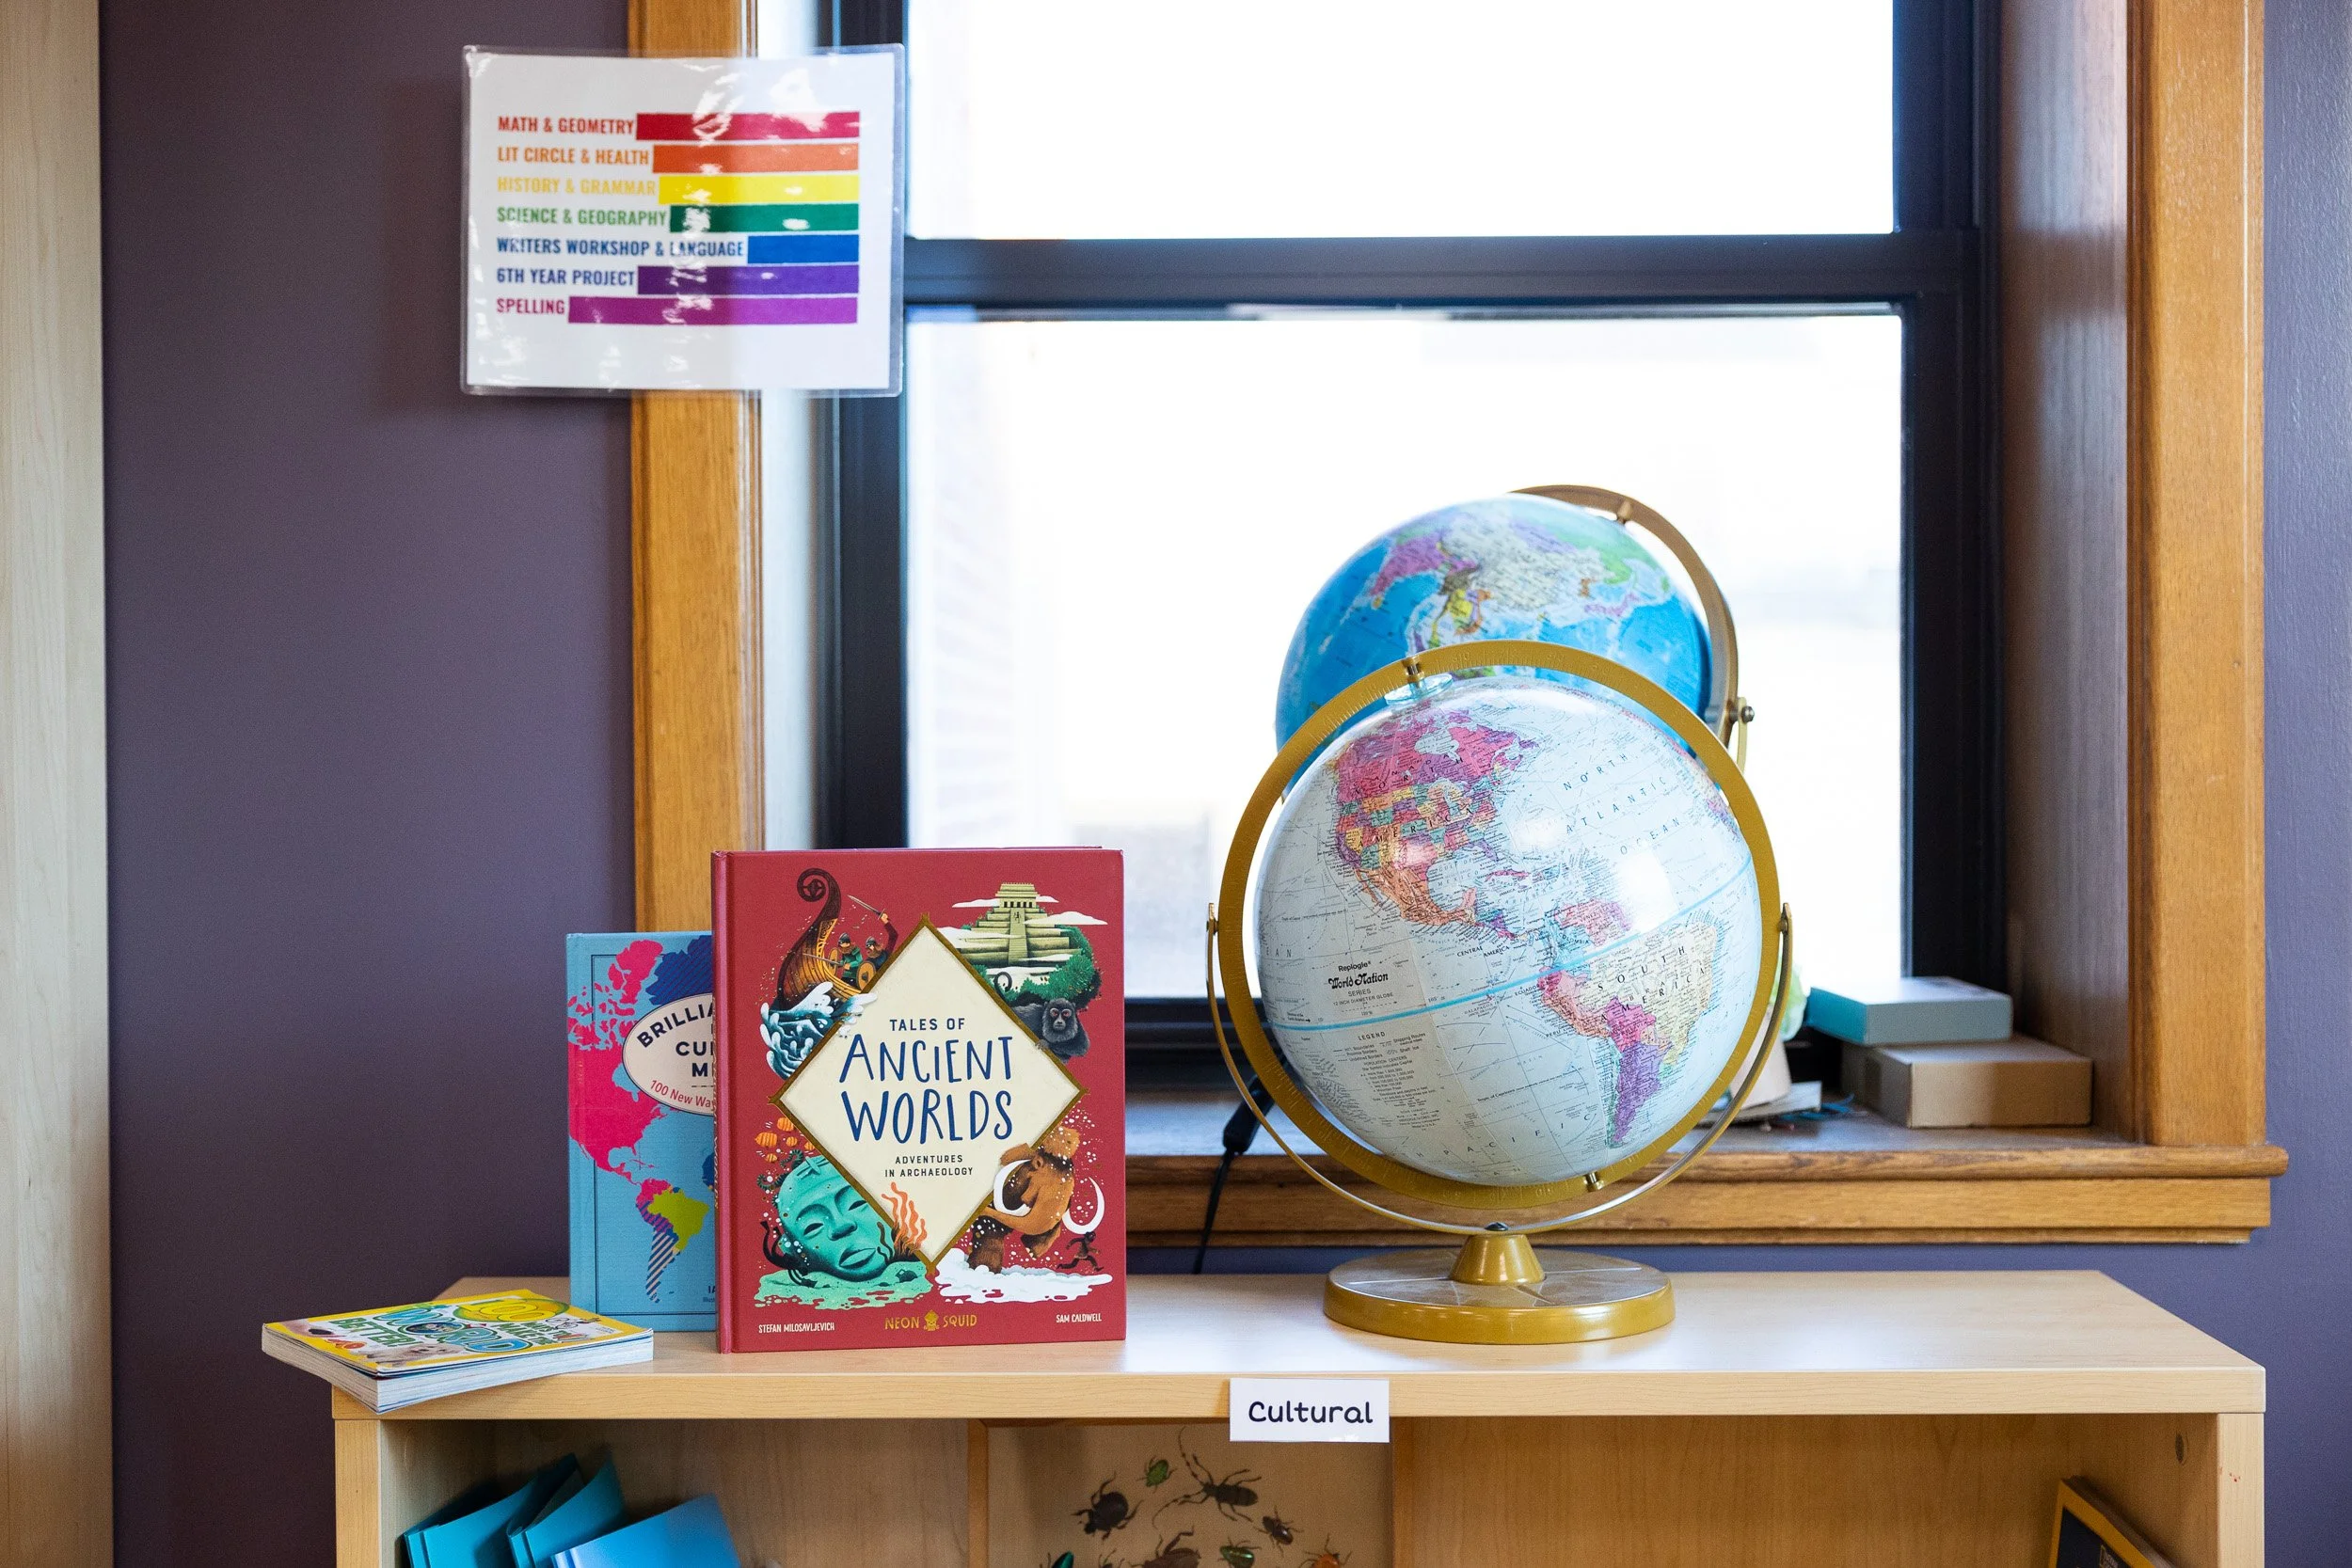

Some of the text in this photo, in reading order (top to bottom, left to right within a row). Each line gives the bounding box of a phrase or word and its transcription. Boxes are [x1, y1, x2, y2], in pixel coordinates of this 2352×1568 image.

[498, 117, 634, 134] MATH & GEOMETRY
[498, 147, 649, 166] LIT CIRCLE & HEALTH
[498, 177, 656, 196] HISTORY & GRAMMAR
[497, 206, 667, 226] SCIENCE & GEOGRAPHY
[497, 238, 743, 257] WRITERS WORKSHOP & LANGUAGE
[497, 267, 635, 286] 6TH YEAR PROJECT
[497, 298, 565, 314] SPELLING
[1564, 753, 1628, 791] NORTH
[1566, 777, 1666, 834] ATLANTIC
[1456, 945, 1484, 958] CENTRAL
[1484, 945, 1510, 958] AMERICA
[1598, 946, 1685, 991] SOUTH
[1327, 972, 1389, 990] World Nation
[1347, 988, 1372, 997] SERIES
[1350, 995, 1376, 1005] DIAMETER
[889, 1018, 965, 1032] TALES OF
[1358, 1031, 1386, 1041] LEGEND
[839, 1034, 1013, 1083] ANCIENT
[650, 1080, 669, 1096] 100
[670, 1088, 693, 1104] New
[840, 1088, 1013, 1145] WORLDS
[895, 1154, 963, 1164] ADVENTURES
[884, 1166, 974, 1178] IN ARCHAEOLOGY
[455, 1298, 557, 1323] 100
[1056, 1313, 1103, 1323] SAM CALDWELL
[372, 1307, 534, 1354] WORLD
[758, 1323, 835, 1334] STEFAN MILOSAVLJEVICH
[884, 1314, 977, 1330] NEON SQUID
[327, 1317, 425, 1348] BETTER!
[1248, 1401, 1374, 1424] Cultural
